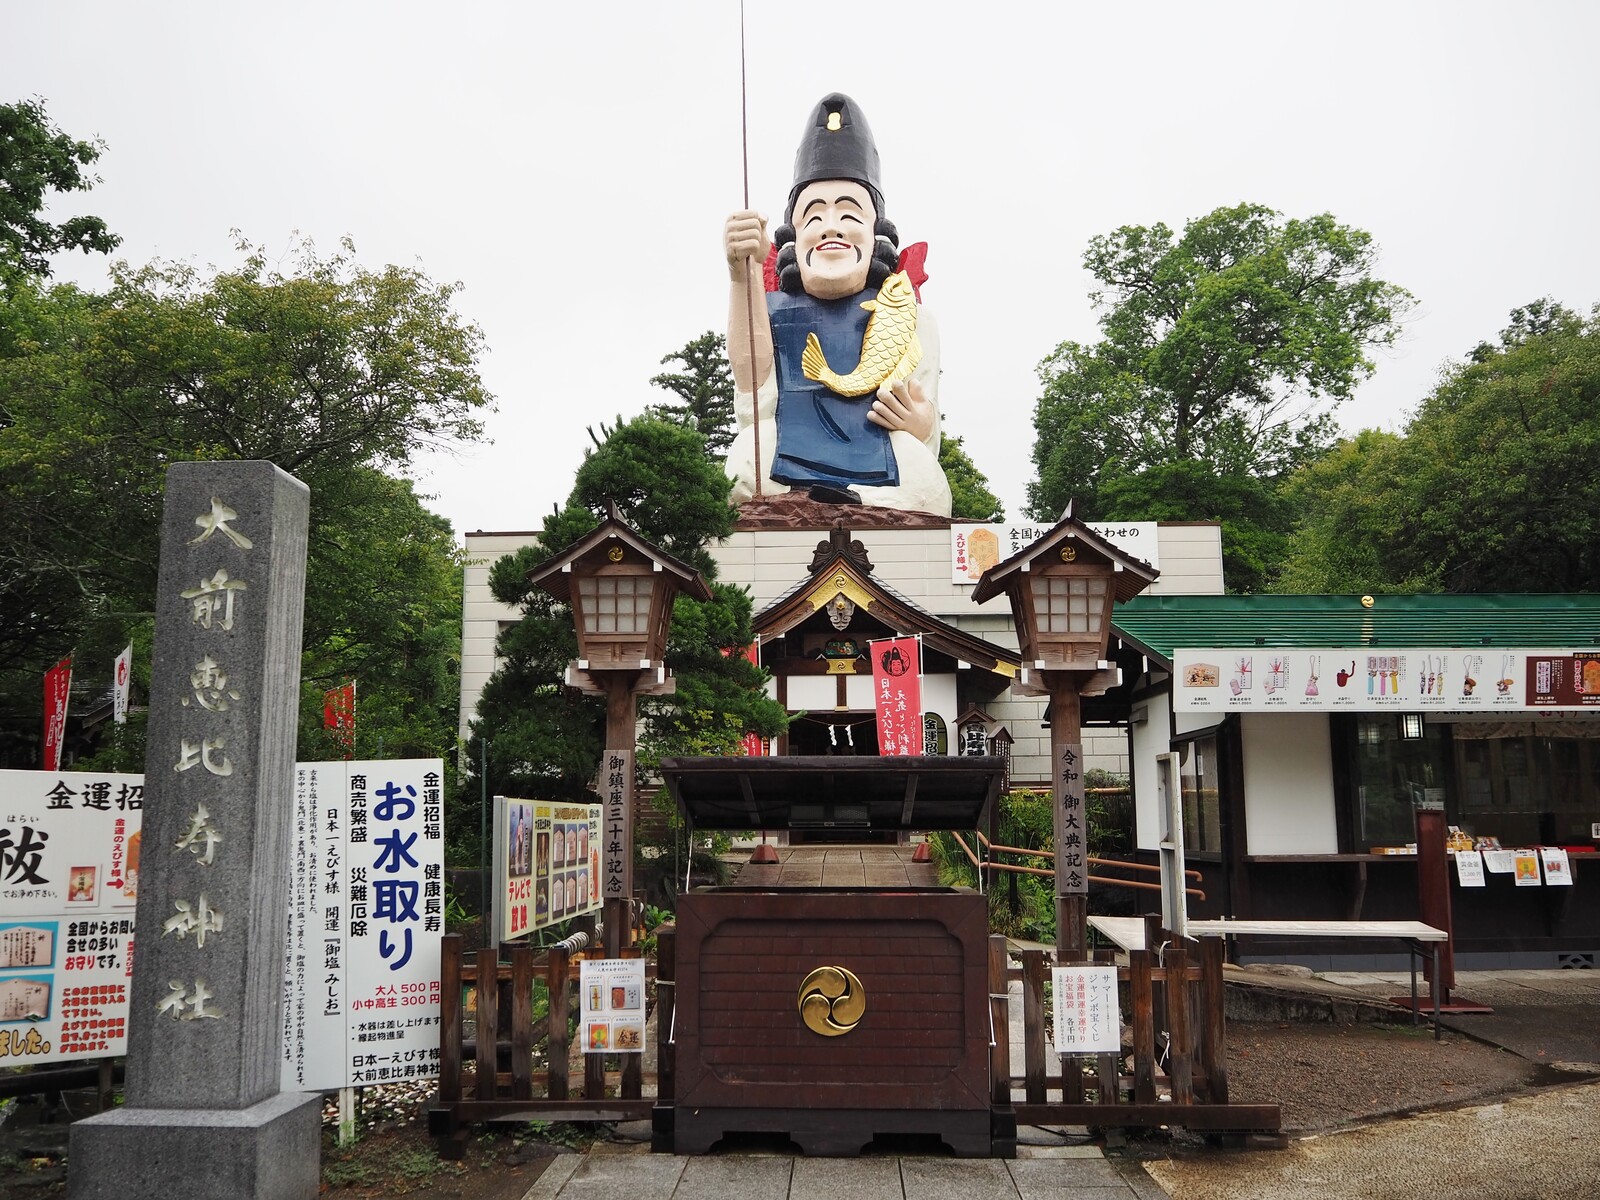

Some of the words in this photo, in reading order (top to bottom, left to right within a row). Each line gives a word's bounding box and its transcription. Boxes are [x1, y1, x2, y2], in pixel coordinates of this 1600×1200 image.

[956, 533, 966, 564] えびす様
[924, 718, 938, 756] 金運招
[155, 496, 253, 1021] 大前恵比寿神社
[1061, 749, 1079, 784] 令和
[350, 774, 368, 843] 商売繁盛
[423, 771, 440, 840] 金運招福
[607, 755, 625, 892] 御鎮座三十年記念
[111, 818, 126, 878] 金運のえびす様
[324, 808, 341, 895] 日本一えびす様
[1063, 794, 1082, 888] 御大典記念
[372, 781, 420, 971] お水取り
[508, 878, 531, 902] テレビで
[350, 866, 368, 937] 災難厄除
[423, 863, 441, 932] 健康長寿
[324, 905, 340, 932] 開運
[65, 954, 121, 971] お守りです。
[67, 937, 119, 953] 合せの多い
[352, 997, 398, 1011] 小中高生
[401, 995, 426, 1006] 300
[429, 993, 440, 1004] 円
[375, 984, 398, 996] 大人
[400, 982, 426, 993] 500
[429, 981, 440, 992] 円
[1065, 975, 1075, 1009] お宝福袋
[1102, 974, 1111, 1003] サマー
[1089, 974, 1100, 1042] ジャンボ宝くじ
[352, 1062, 441, 1083] 大前恵比寿神社
[353, 1047, 441, 1068] 日本一えびす様
